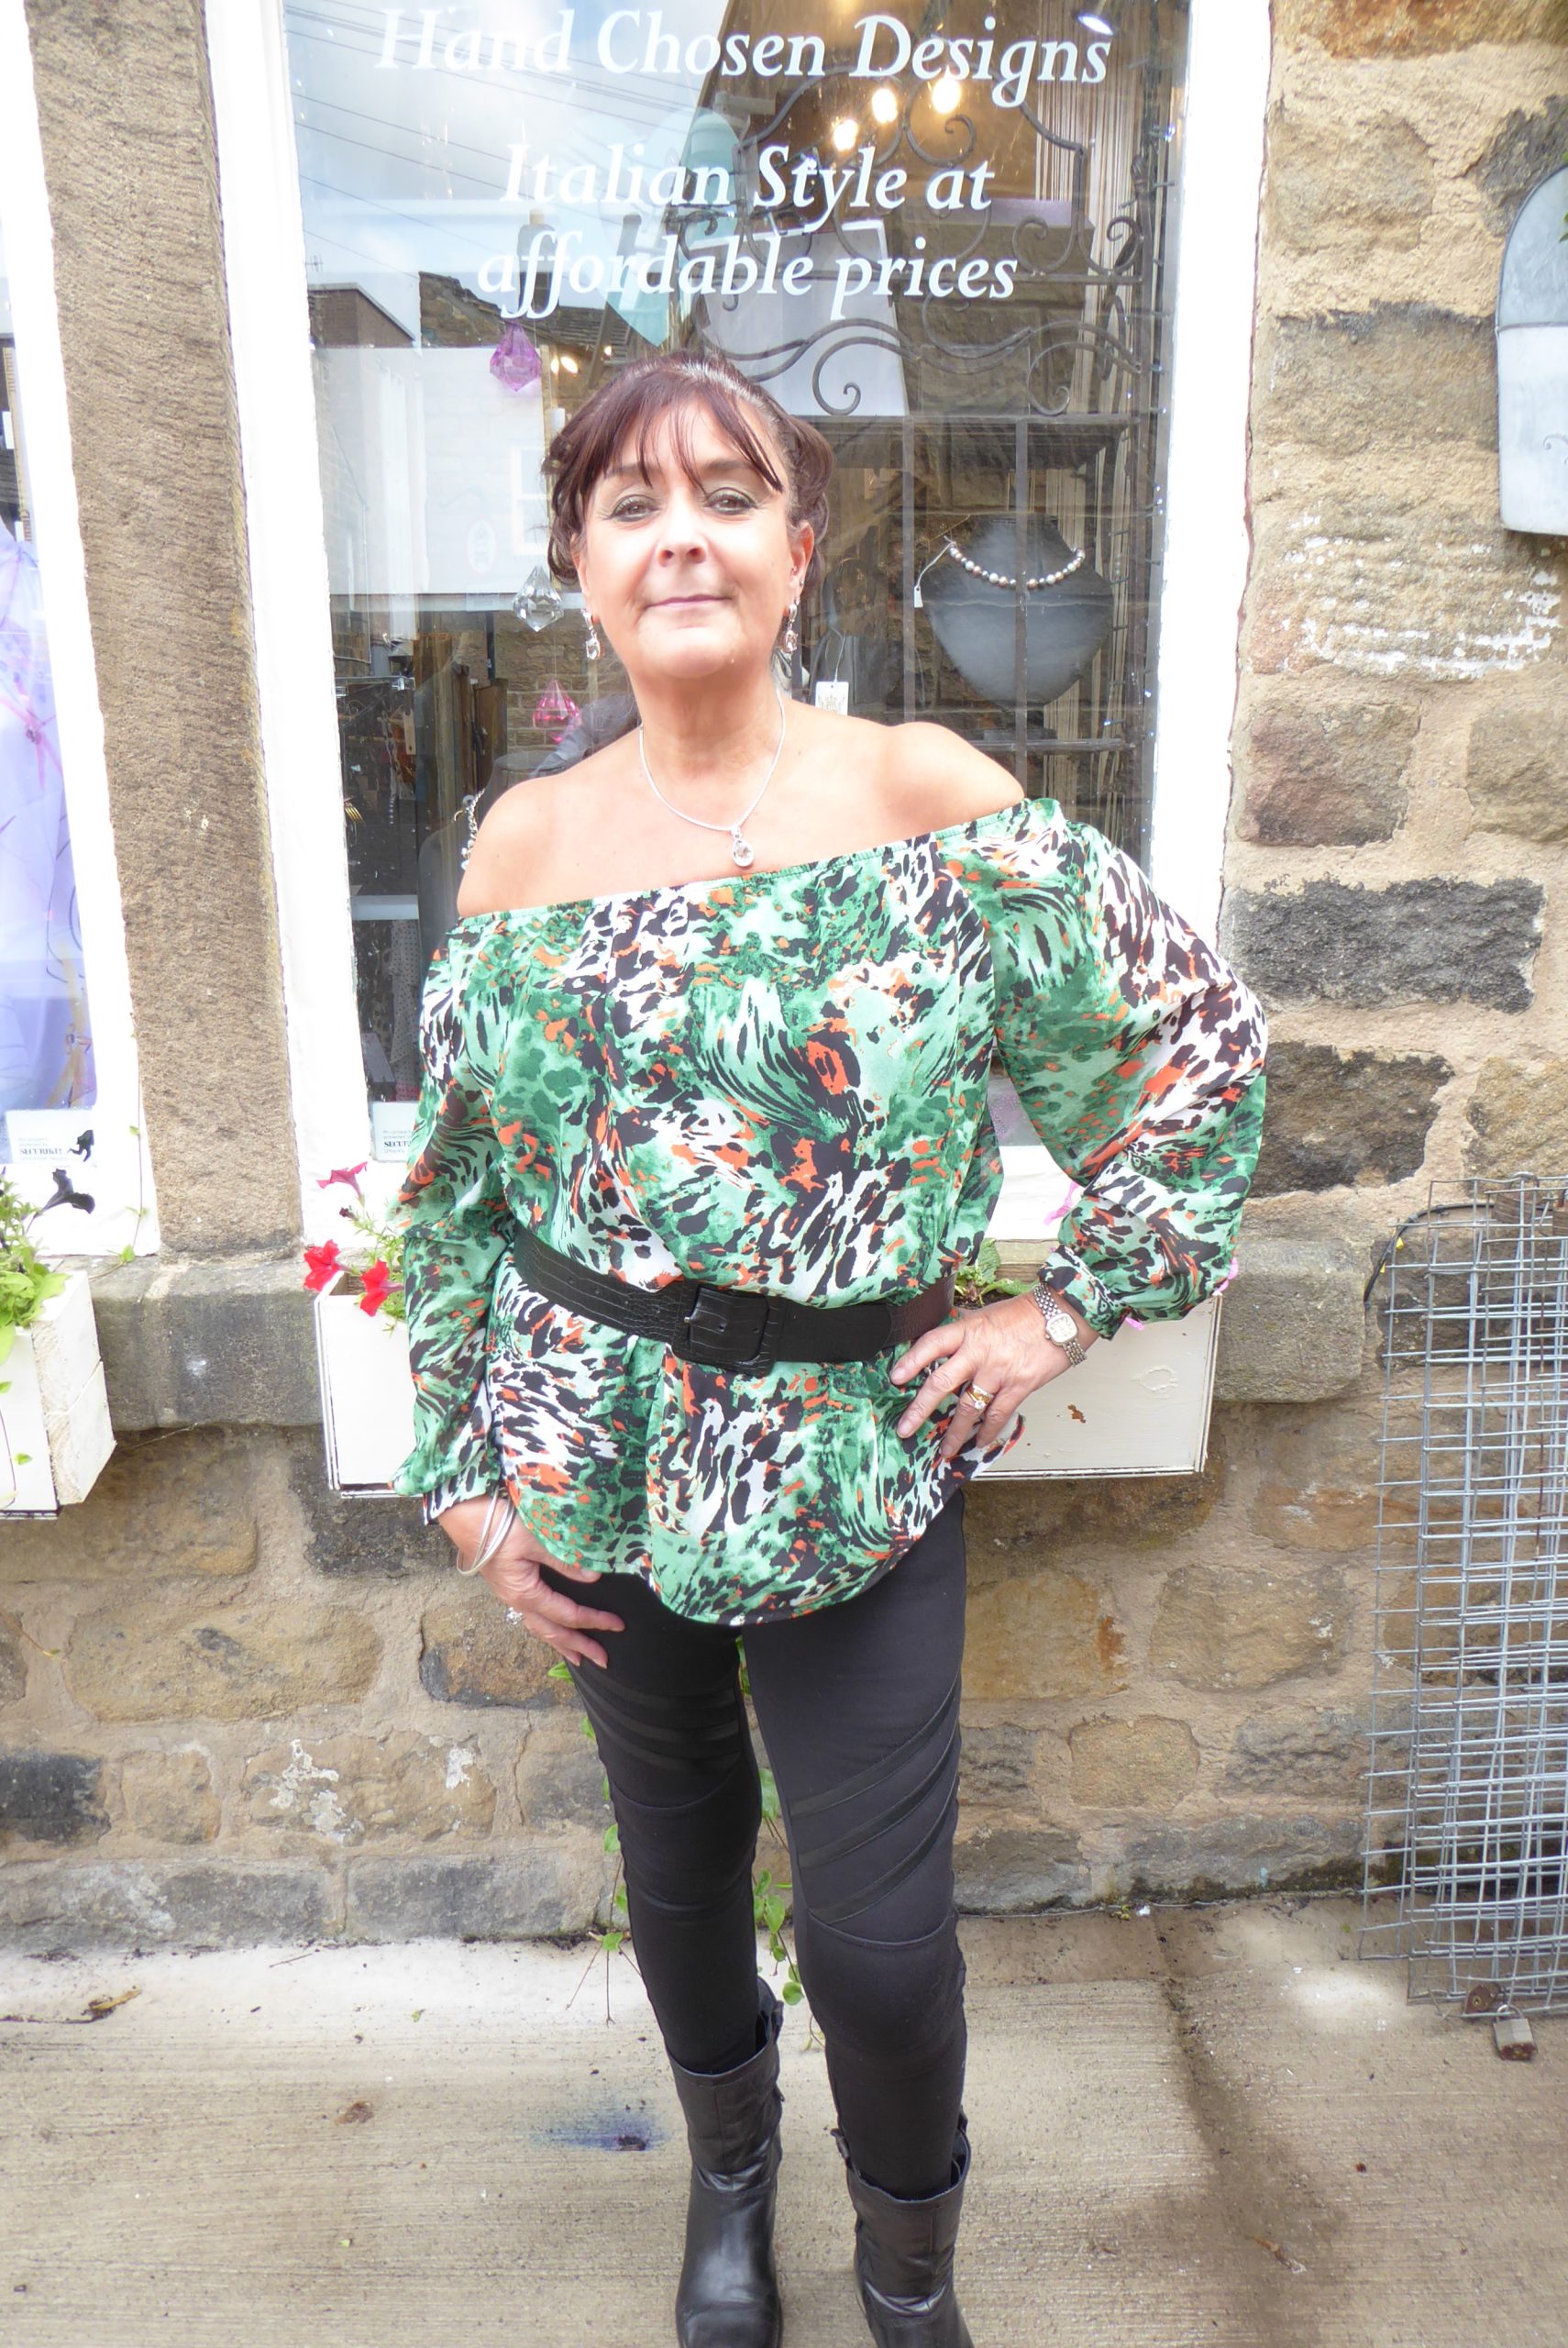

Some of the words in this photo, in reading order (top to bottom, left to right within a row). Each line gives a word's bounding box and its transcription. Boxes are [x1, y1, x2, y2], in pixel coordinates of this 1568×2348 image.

[374, 8, 575, 72] Hand
[597, 9, 826, 77] Chosen
[849, 14, 1111, 108] Designs
[499, 141, 734, 206] Italian
[753, 145, 908, 234] Style
[926, 161, 996, 211] at
[477, 229, 814, 319] affordable
[829, 236, 1018, 321] prices
